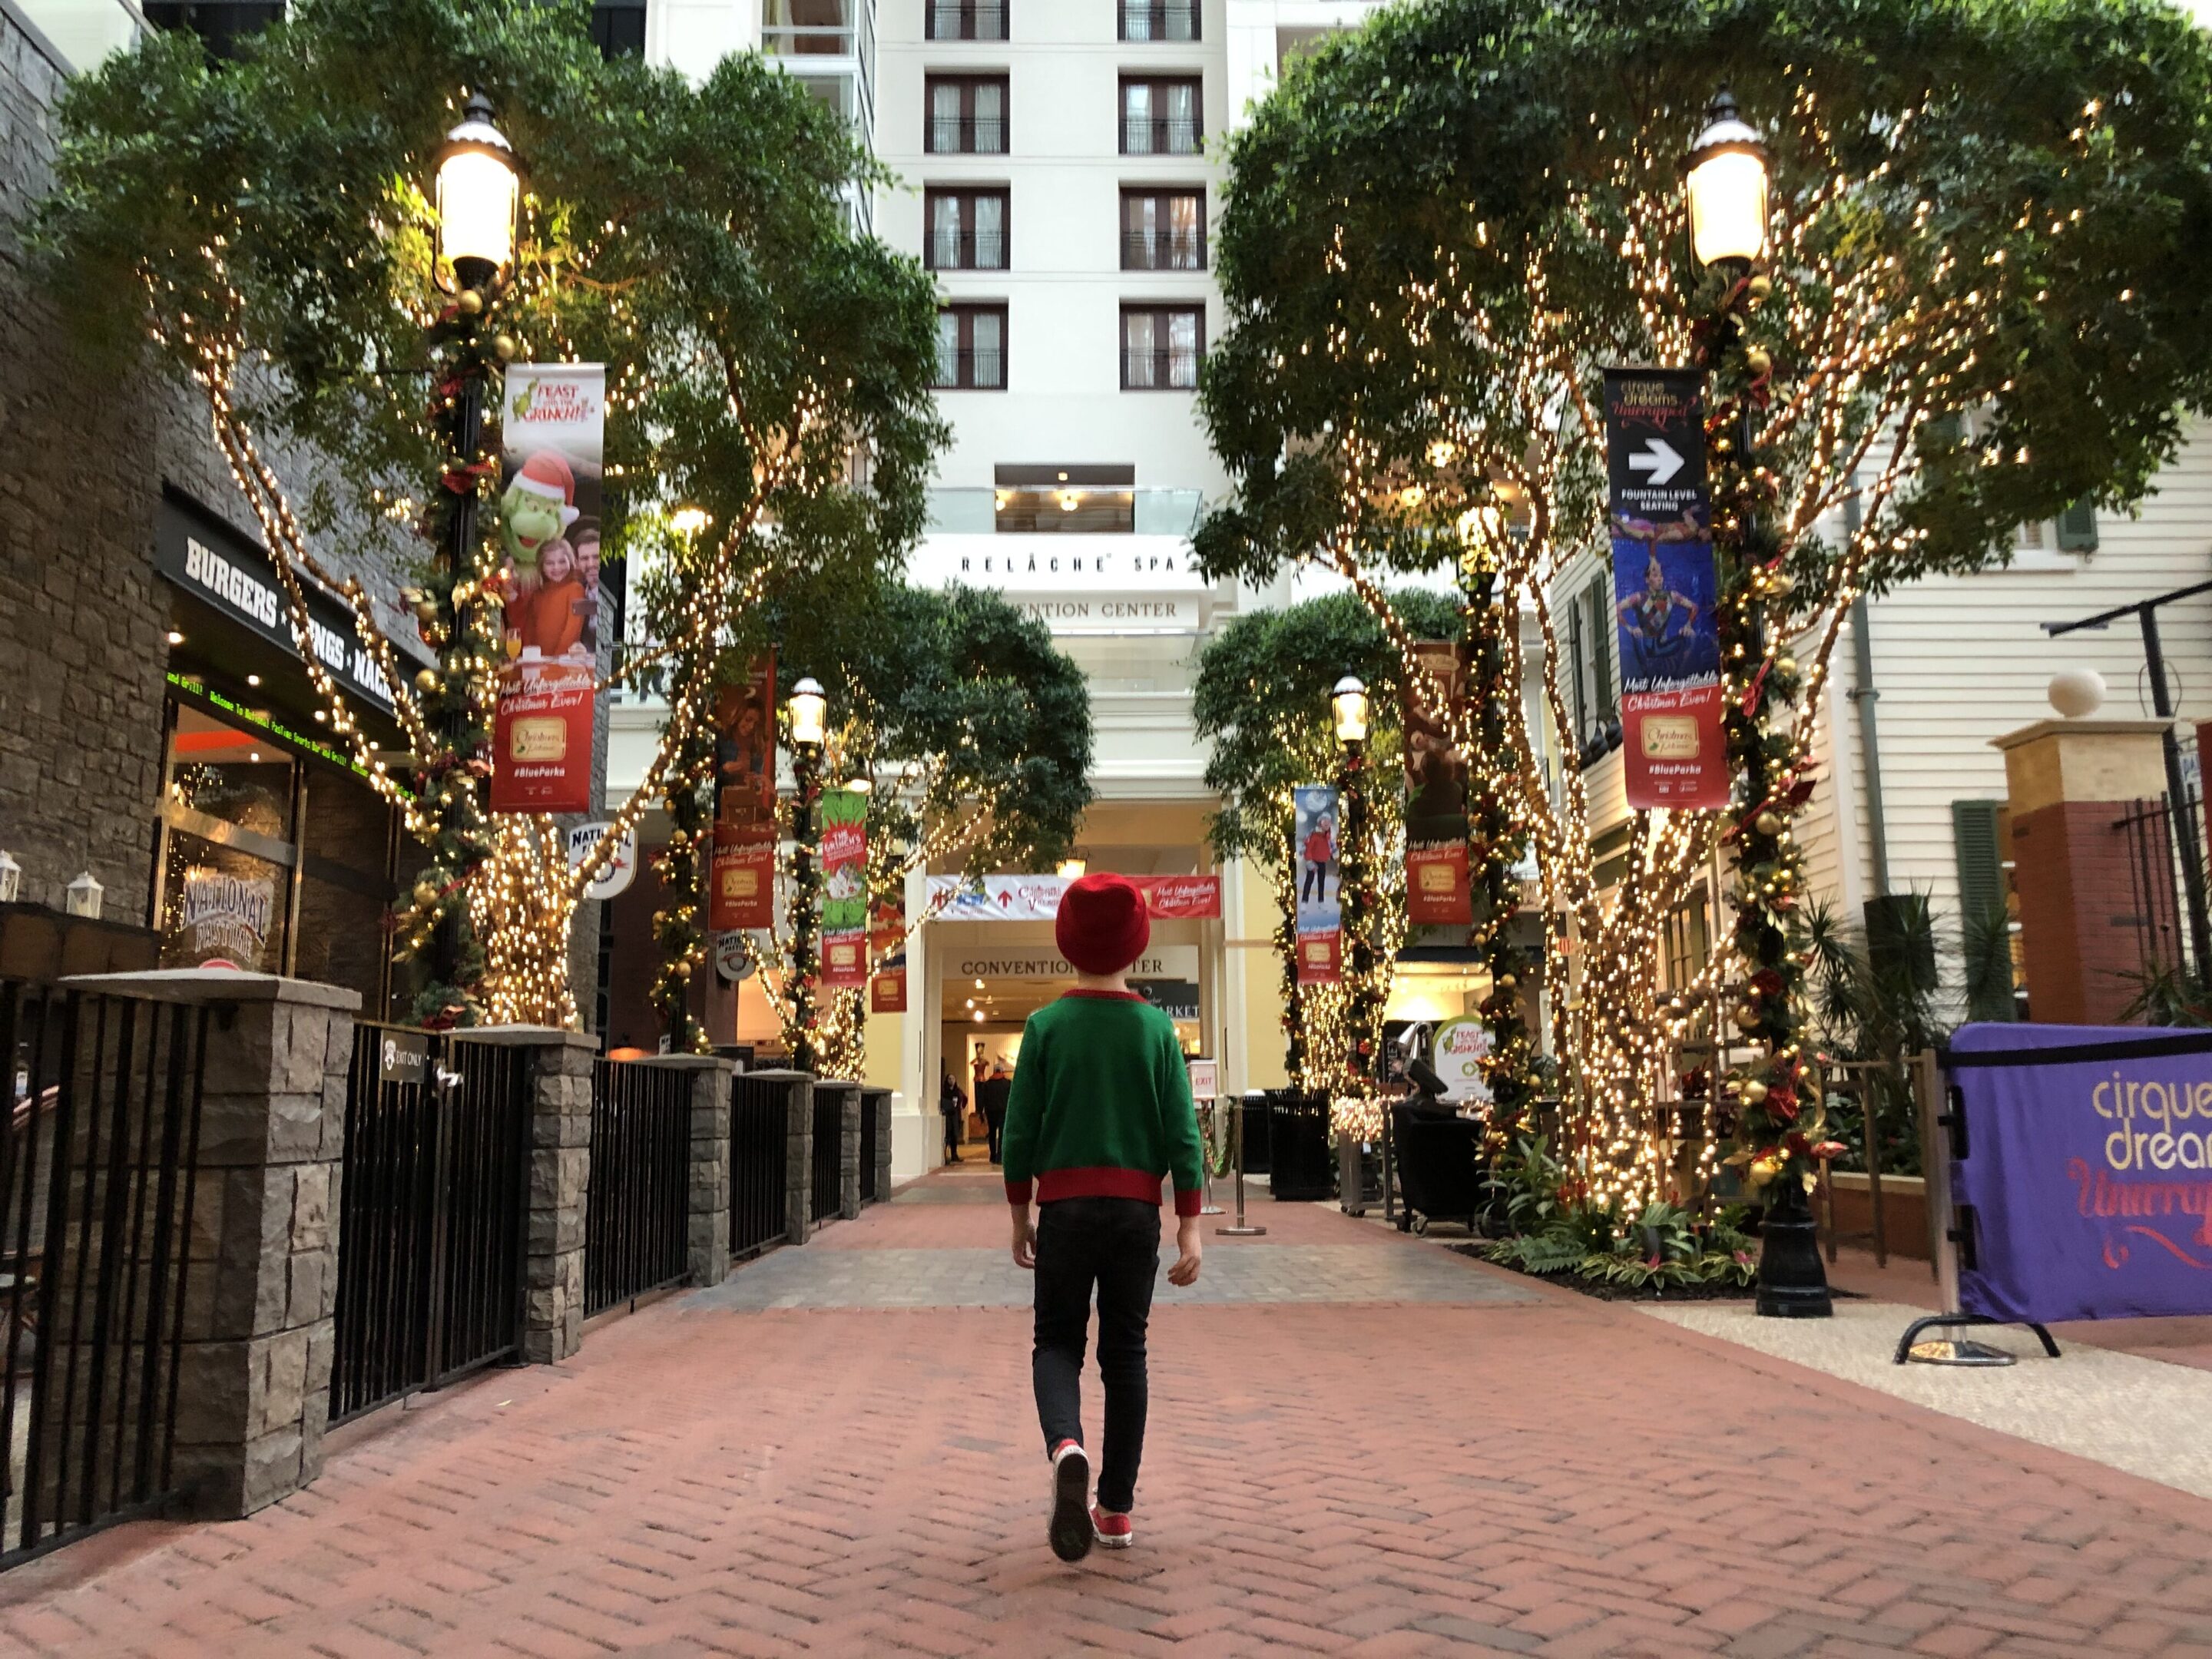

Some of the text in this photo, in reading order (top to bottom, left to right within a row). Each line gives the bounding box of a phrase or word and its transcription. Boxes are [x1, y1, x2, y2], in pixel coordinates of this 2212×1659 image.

[538, 384, 578, 398] FEAST
[1624, 391, 1677, 406] dreams
[1621, 488, 1697, 501] FOUNTAIN LEVEL
[1640, 500, 1678, 512] SEATING
[1134, 556, 1174, 571] SPA
[185, 536, 277, 628] BURGERS
[1015, 602, 1177, 618] ENTION CENTER
[523, 673, 591, 697] Unforgettable
[1624, 669, 1719, 696] Most Unforgettable
[167, 672, 180, 684] and
[180, 676, 204, 696] Grill!
[210, 690, 234, 711] Welcome
[236, 703, 243, 716] To
[245, 707, 270, 729] National
[501, 690, 584, 716] Christmas Ever!
[1628, 688, 1711, 713] Christmas Ever!
[514, 765, 565, 778] #BlueParka
[1649, 763, 1701, 775] #BlueParka
[180, 876, 267, 949] NATIONAL
[195, 920, 253, 964] PASTIME
[1132, 959, 1163, 973] TER
[1159, 1005, 1199, 1018] RKET
[396, 1050, 422, 1067] EXIT ONLY
[1195, 1076, 1211, 1085] EXIT
[2092, 1071, 2212, 1134] cirque
